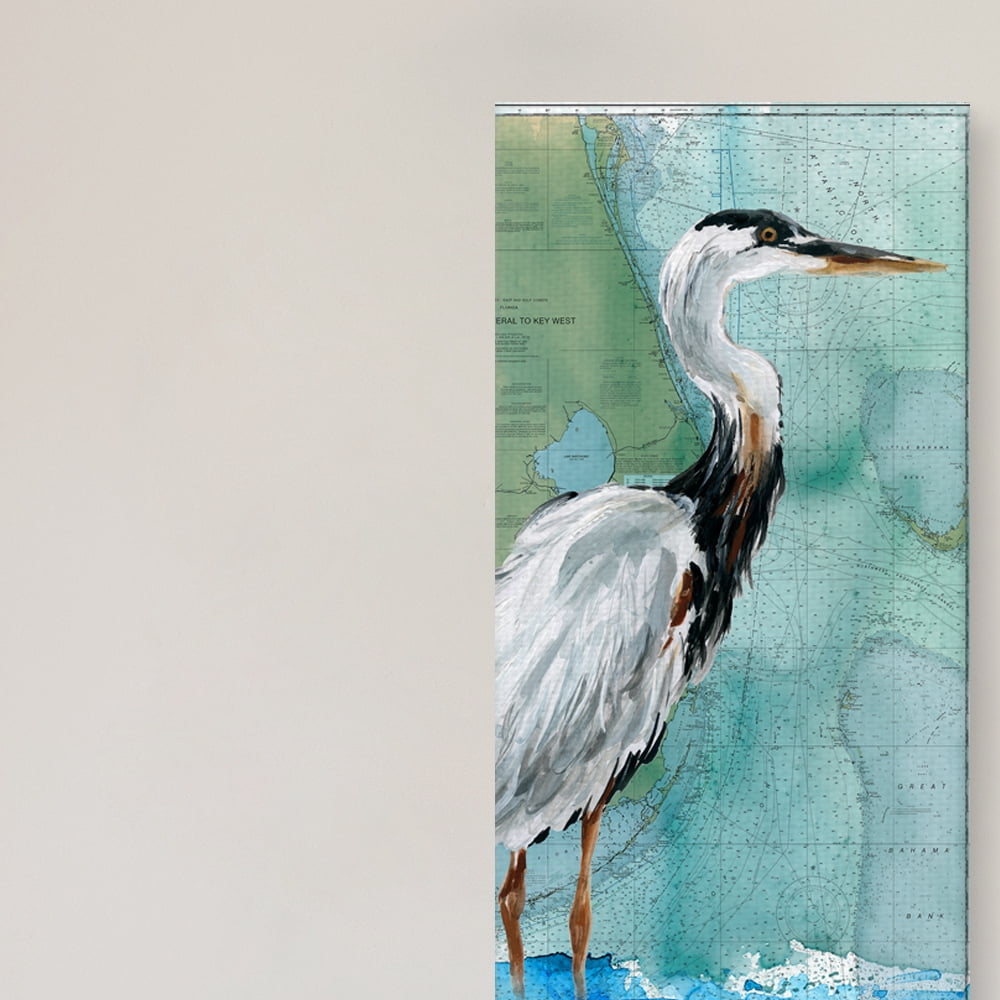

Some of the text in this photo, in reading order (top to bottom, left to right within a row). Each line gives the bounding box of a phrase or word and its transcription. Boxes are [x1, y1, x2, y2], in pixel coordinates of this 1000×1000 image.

[495, 316, 576, 325] ERAL TO KEY WEST
